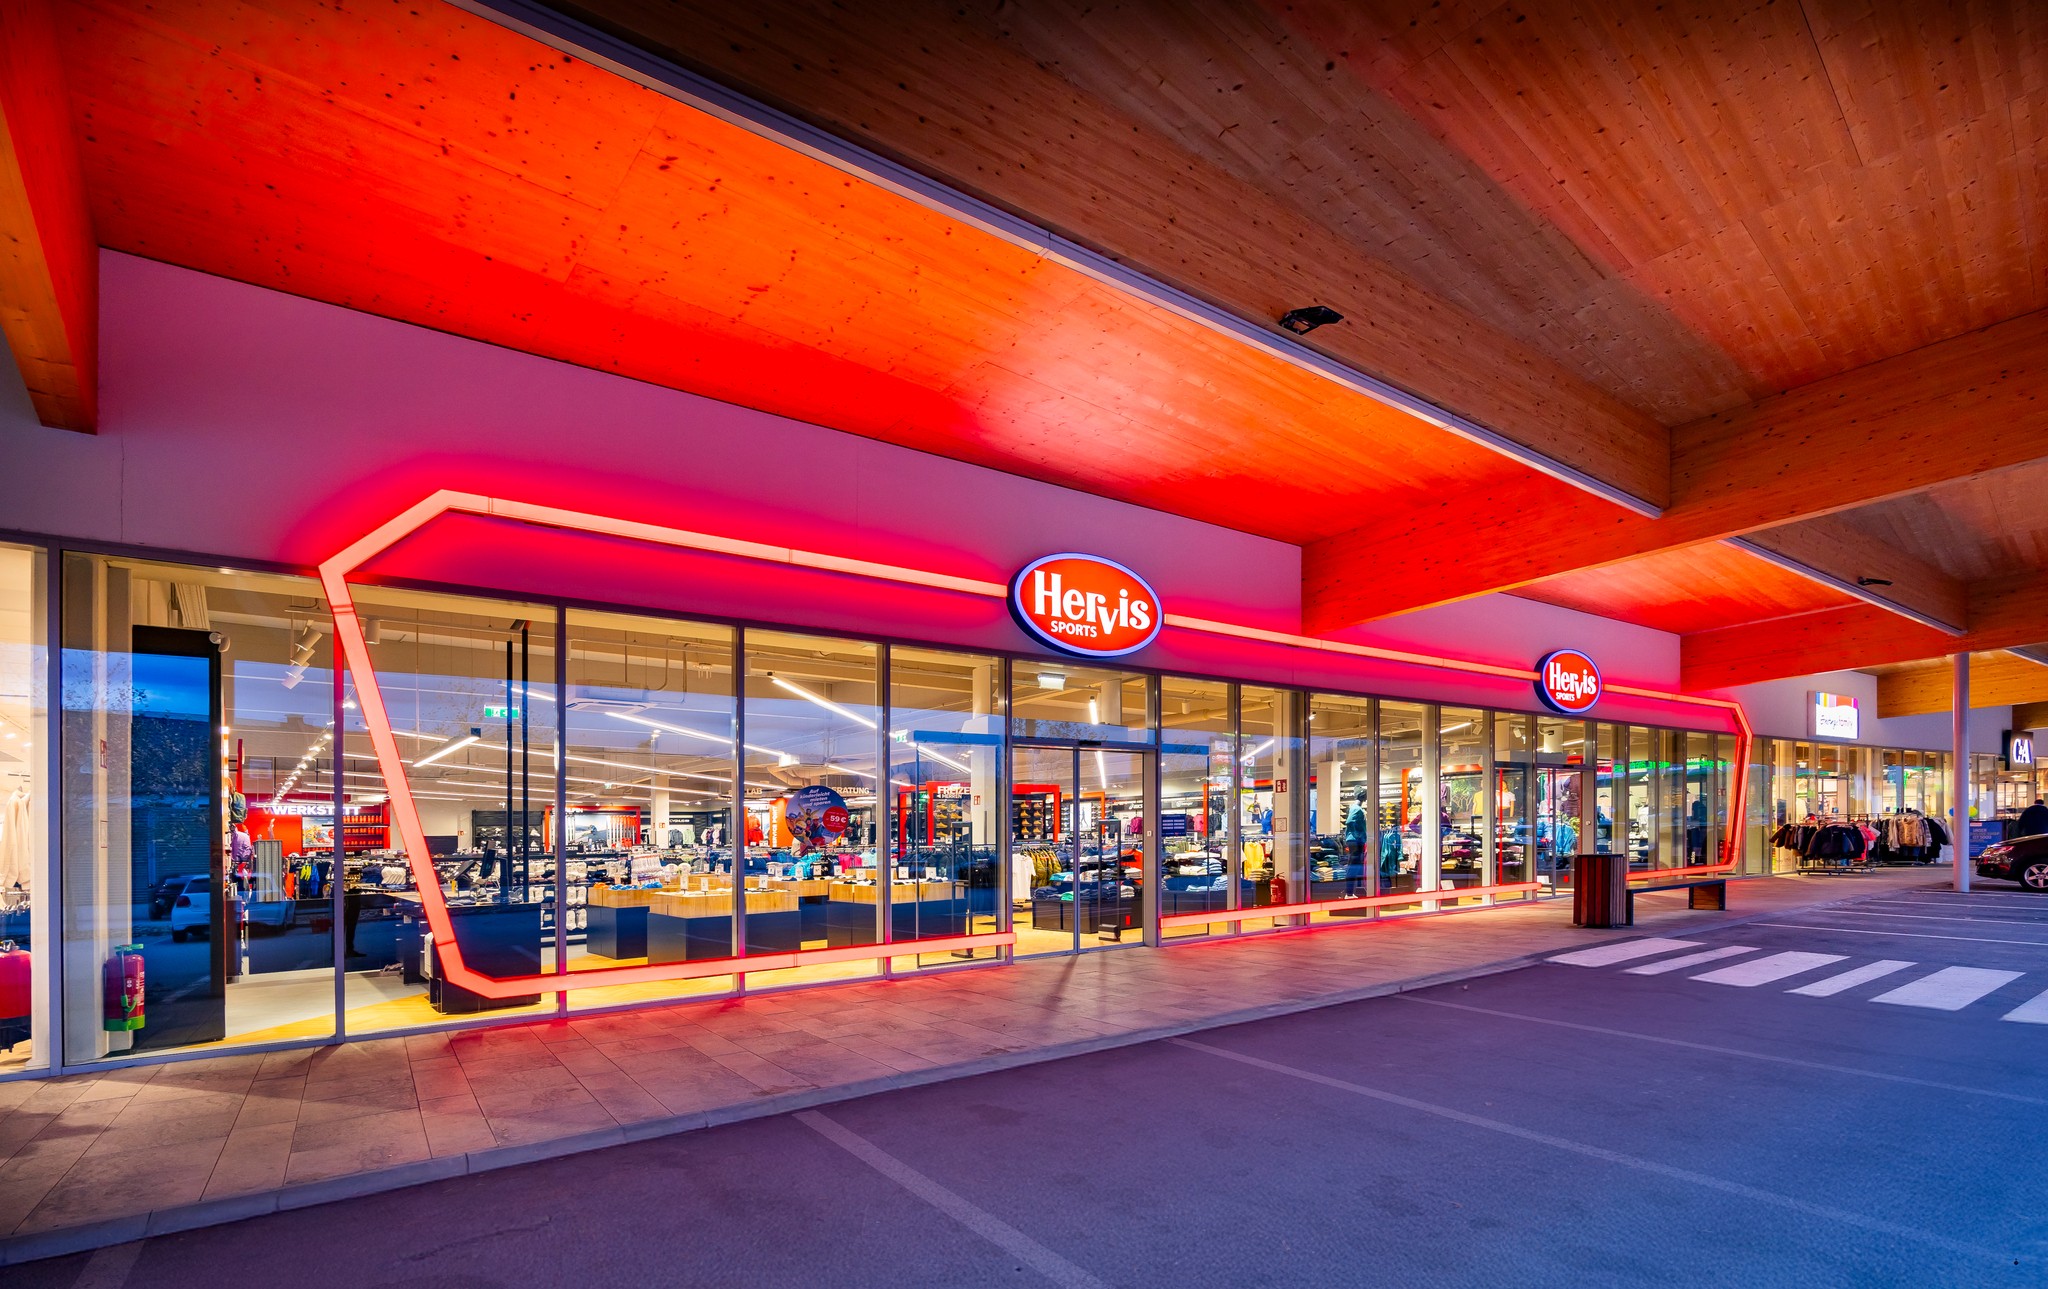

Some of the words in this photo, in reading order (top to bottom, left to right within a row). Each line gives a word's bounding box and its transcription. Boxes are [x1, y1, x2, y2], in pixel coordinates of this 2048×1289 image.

[1034, 569, 1150, 635] Hervis
[1050, 620, 1098, 638] SPORTS
[1549, 661, 1597, 699] Hervis
[1555, 692, 1575, 702] SPORTS
[2013, 738, 2033, 764] C&A
[830, 786, 870, 795] ERATUNG
[937, 785, 971, 795] FREIZE
[271, 805, 361, 816] WERKSTTT
